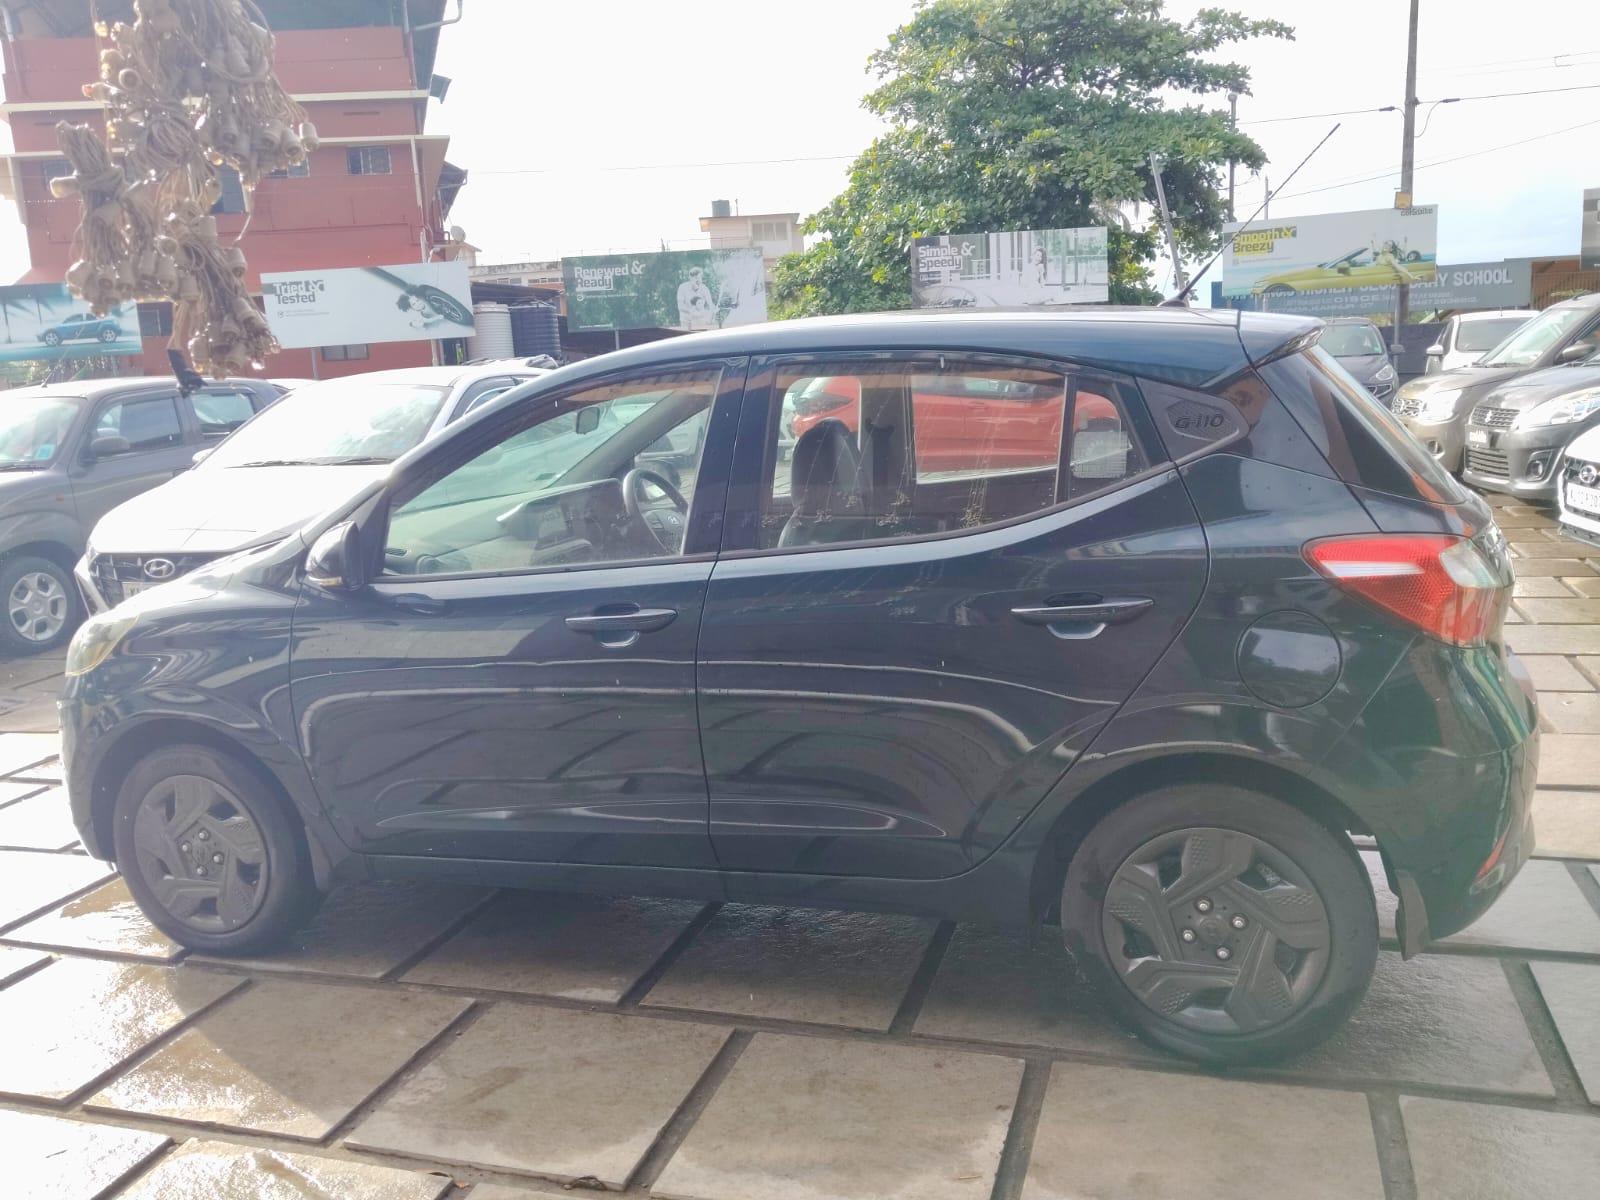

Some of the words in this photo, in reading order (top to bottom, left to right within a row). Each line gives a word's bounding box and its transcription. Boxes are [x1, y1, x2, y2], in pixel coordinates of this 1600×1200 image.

[1232, 228, 1280, 242] Smooth
[918, 244, 959, 259] Simple
[960, 241, 976, 256] &
[1232, 240, 1274, 253] Breezy
[574, 263, 629, 279] Renewed
[631, 260, 646, 275] &
[919, 255, 962, 270] Speedy
[576, 276, 612, 289] Ready
[1453, 268, 1513, 287] SCHOOL
[273, 280, 304, 296] Tried
[275, 290, 316, 305] Tested
